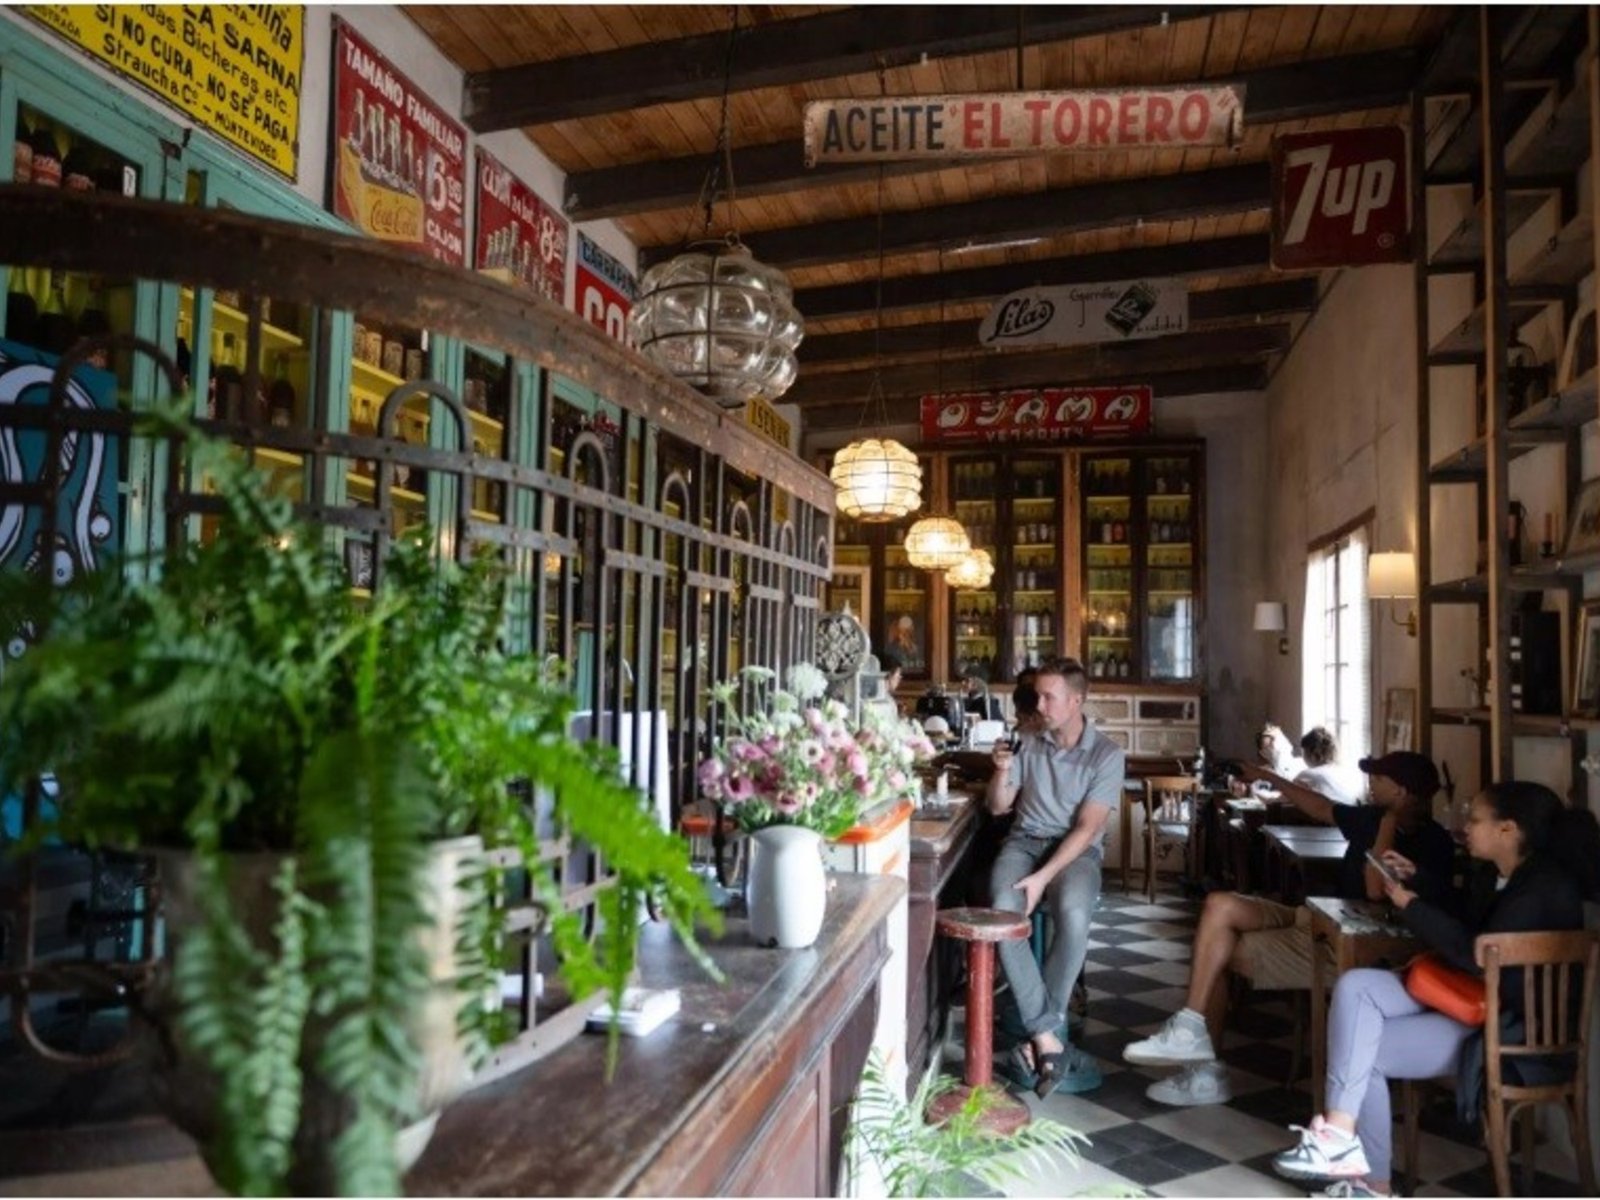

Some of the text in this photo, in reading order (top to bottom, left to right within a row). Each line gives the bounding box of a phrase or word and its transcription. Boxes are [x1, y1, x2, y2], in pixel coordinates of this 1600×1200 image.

[94, 5, 115, 29] SI
[122, 14, 145, 47] NO
[151, 35, 194, 82] CURA
[206, 73, 226, 103] NO
[229, 89, 250, 119] SE
[254, 105, 289, 146] PAGA
[103, 33, 168, 90] Strauch
[183, 19, 258, 94] Bicheras
[223, 22, 299, 98] SARNA
[406, 93, 462, 161] FAMILIAR
[822, 104, 945, 154] ACEITE
